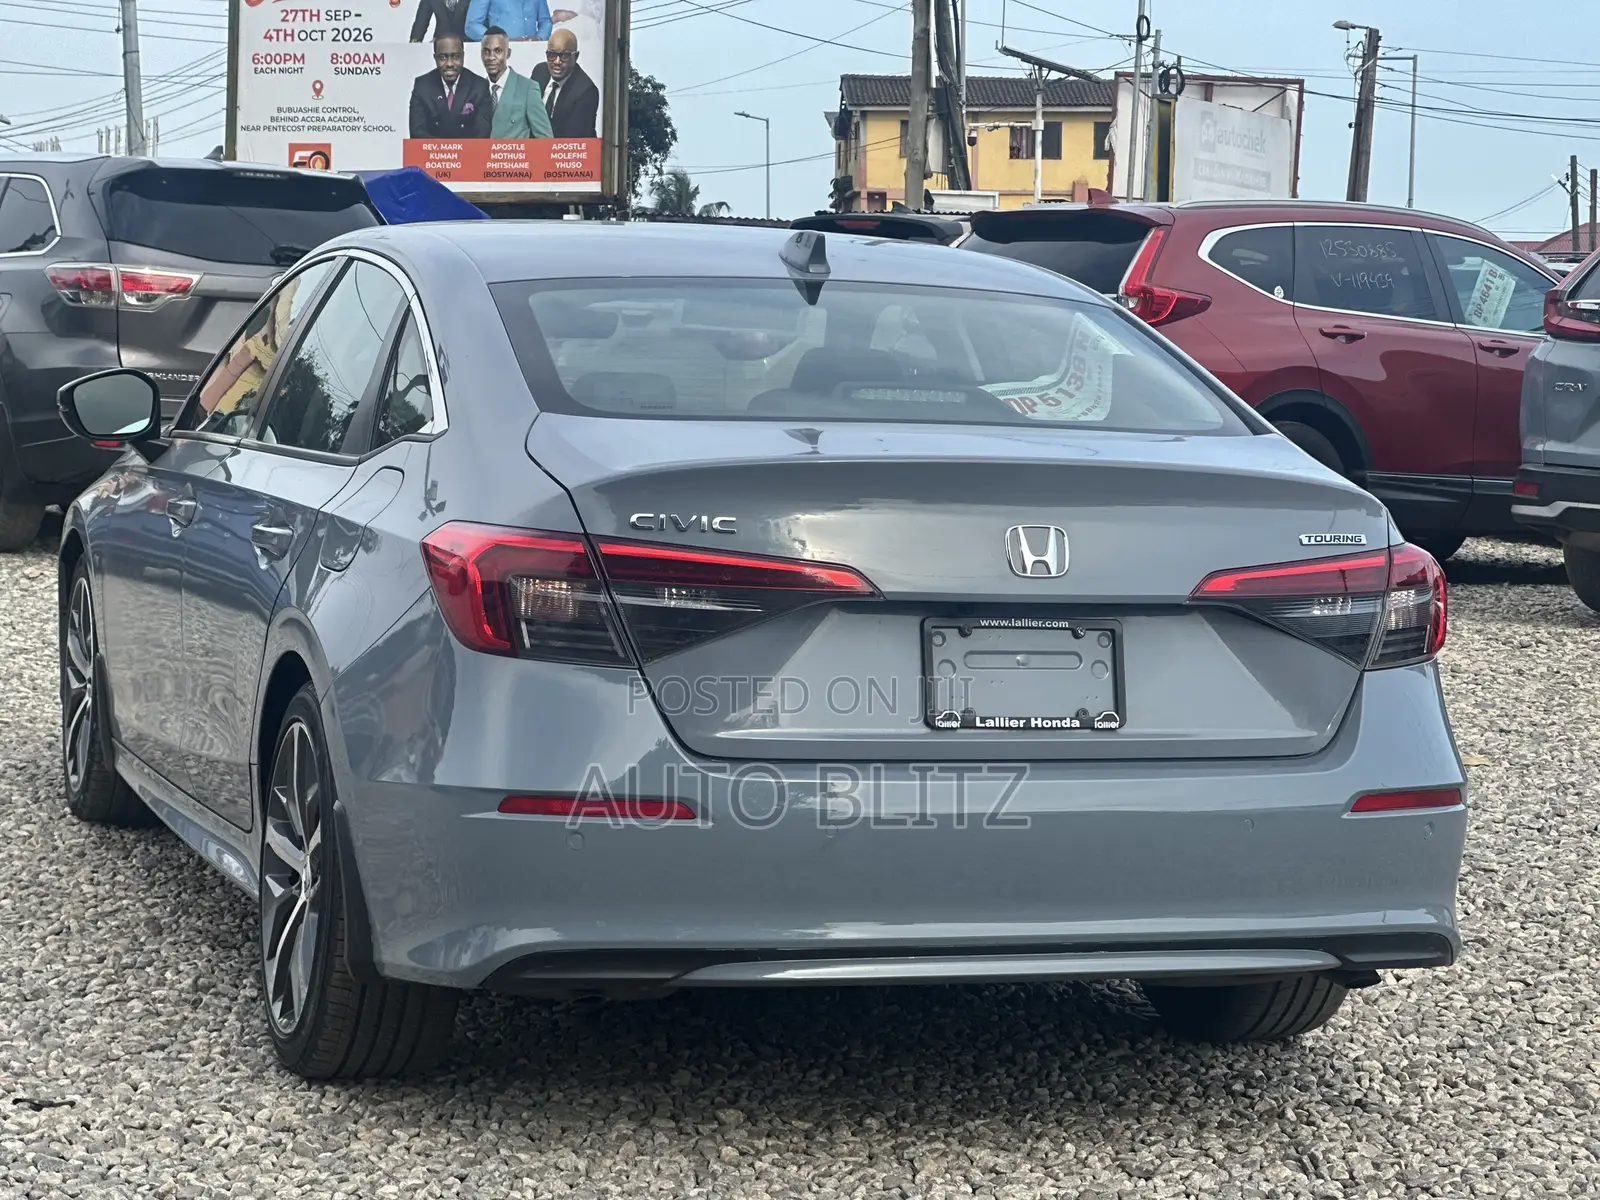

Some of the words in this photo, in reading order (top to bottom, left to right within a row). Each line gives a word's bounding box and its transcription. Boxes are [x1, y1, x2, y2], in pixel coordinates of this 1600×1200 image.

[280, 9, 320, 22] 27TH
[263, 28, 295, 42] 4TH
[297, 30, 326, 42] OCT
[331, 27, 373, 42] 2026
[252, 53, 305, 65] 6:00PM
[330, 53, 385, 65] 8:00AM
[254, 67, 276, 75] EACH
[278, 67, 304, 75] NIGHT
[334, 67, 381, 75] SUNDAYS
[276, 106, 320, 114] BUBUASHIE
[321, 106, 360, 115] CONTROL,
[270, 115, 299, 123] BEHIND
[300, 115, 326, 123] ACCRA
[327, 115, 366, 124] ACADEMY,
[1217, 125, 1267, 154] autochek
[422, 143, 440, 151] REV.
[440, 143, 463, 151] MARK
[491, 143, 526, 151] APOSTLE
[429, 152, 458, 160] KUMAH
[490, 152, 526, 160] MOTHUSI
[550, 152, 588, 160] MOLEFHE
[425, 161, 462, 169] BOATENG
[486, 161, 530, 169] PHITSHANE
[555, 161, 583, 169] YHUSO
[483, 171, 533, 179] (BOSTWANA)
[543, 171, 594, 179] (BOSTWANA)
[1480, 277, 1495, 305] 4641
[1488, 268, 1498, 279] B
[1554, 382, 1588, 392] CR-V
[629, 513, 738, 534] CIVIC
[1304, 534, 1362, 543] TOURING
[979, 618, 1069, 629] www.lallier.com
[975, 716, 1026, 728] Lallier
[1030, 717, 1080, 728] Honda
